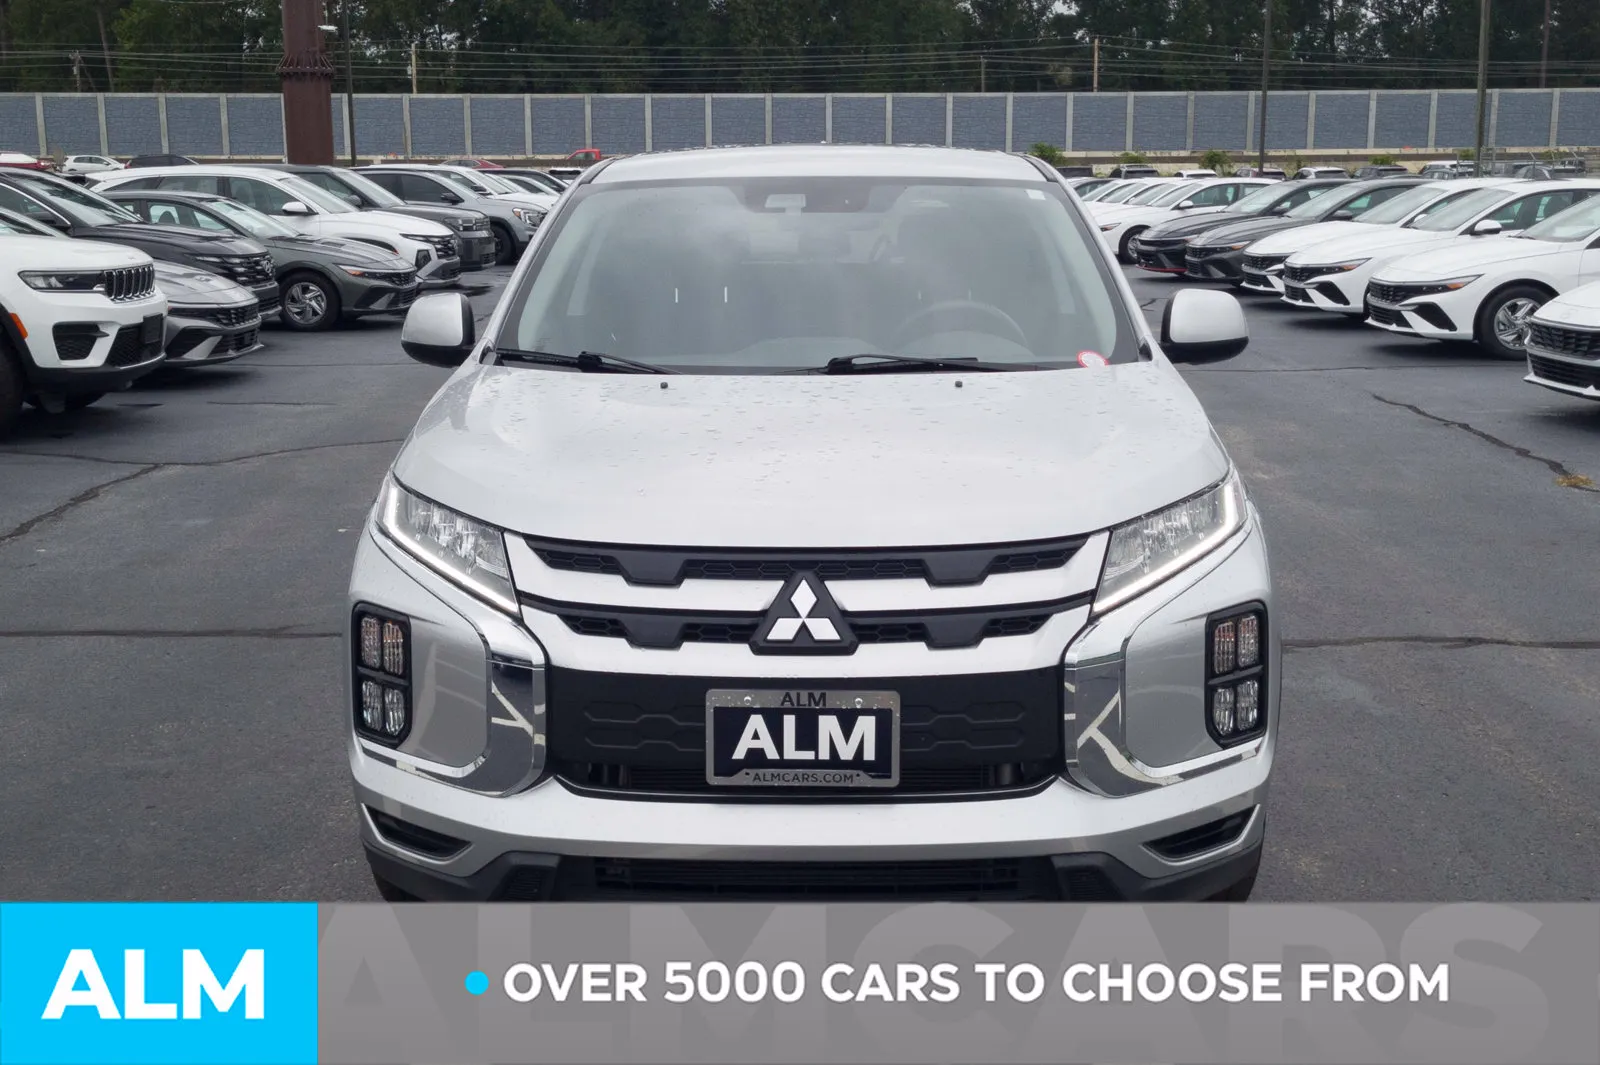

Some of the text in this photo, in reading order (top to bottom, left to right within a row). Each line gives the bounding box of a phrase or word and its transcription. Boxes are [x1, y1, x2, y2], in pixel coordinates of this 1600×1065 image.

[780, 691, 827, 708] ALM
[731, 714, 876, 761] ALM
[752, 771, 854, 784] ALMCARS.COM
